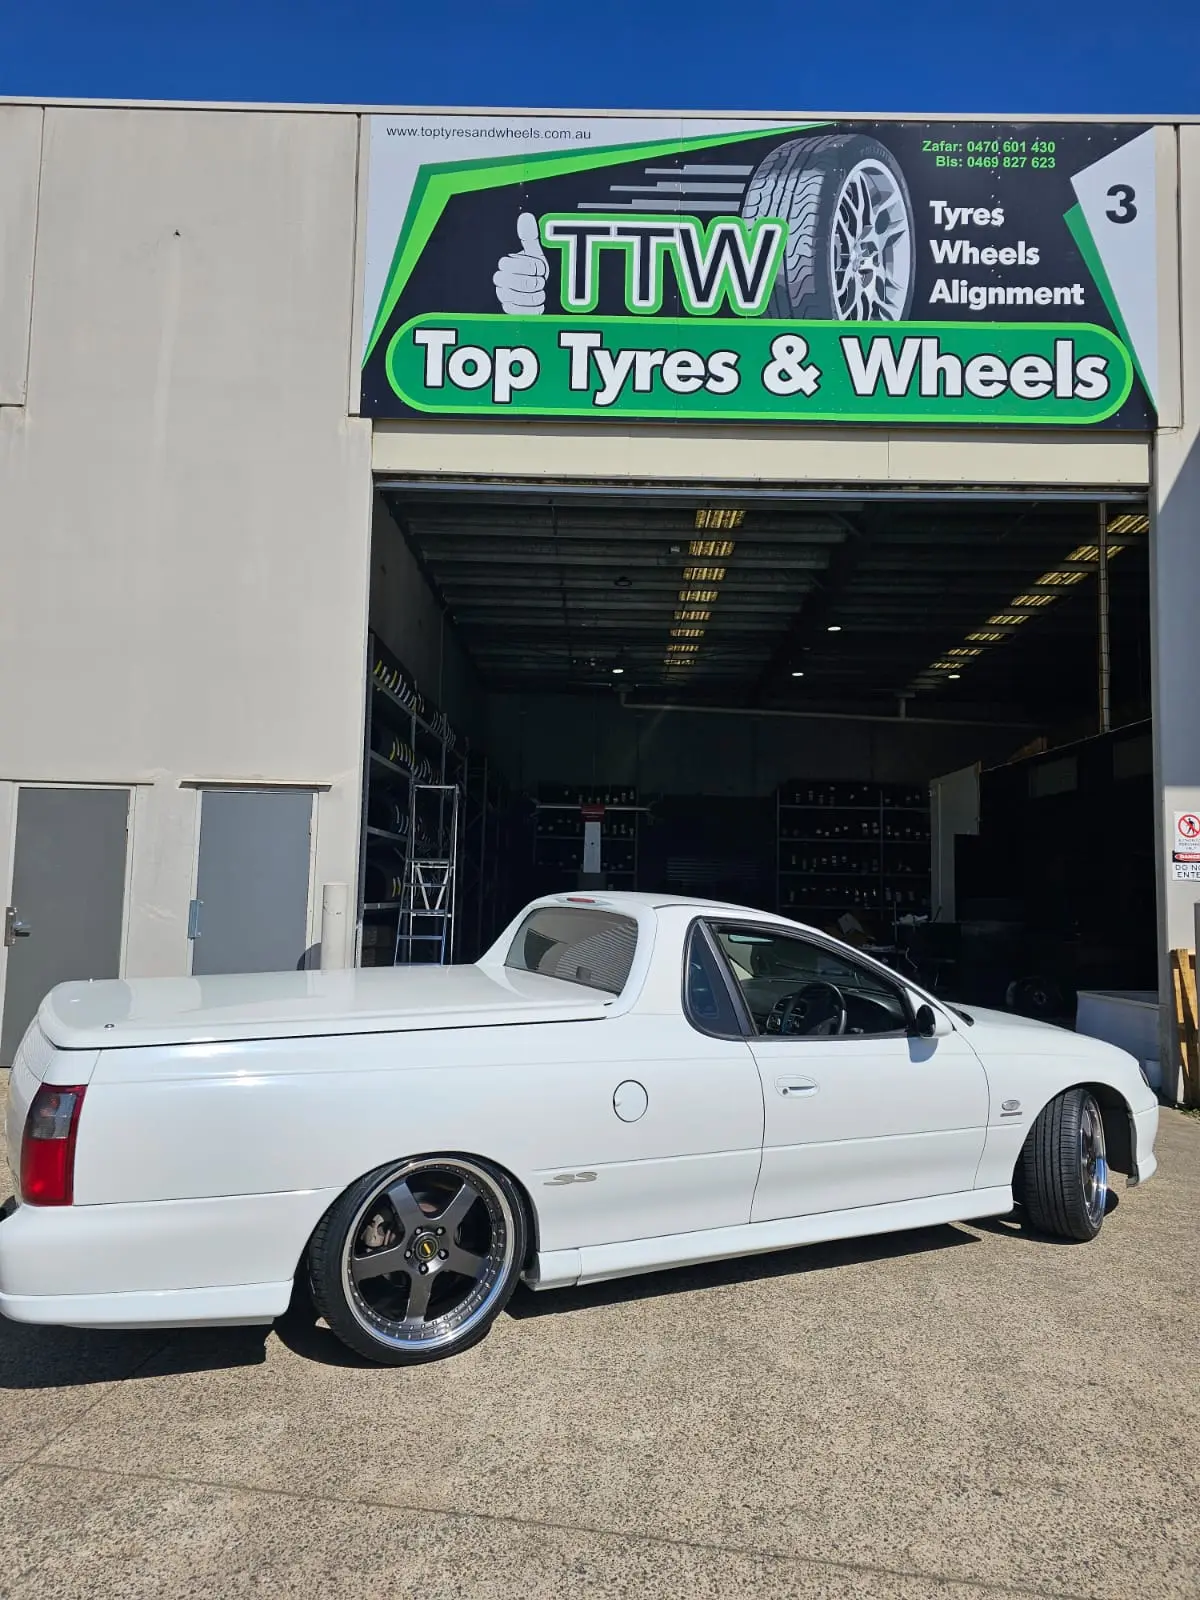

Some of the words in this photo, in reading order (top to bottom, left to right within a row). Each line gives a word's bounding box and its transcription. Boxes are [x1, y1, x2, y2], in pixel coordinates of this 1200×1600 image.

[386, 126, 591, 140] www.toptyresandwheels.com.au
[922, 140, 963, 152] Zafar:
[966, 141, 999, 153] 0470
[1002, 141, 1026, 153] 601
[1030, 141, 1056, 153] 430
[936, 155, 963, 167] Bis:
[966, 156, 999, 168] 0469
[1002, 156, 1027, 168] 827
[1031, 157, 1056, 168] 623
[929, 200, 1005, 230] Tyres
[1105, 184, 1138, 224] 3
[539, 214, 789, 315] TTW
[929, 239, 1040, 265] Wheels
[929, 280, 1085, 310] Alignment
[413, 328, 540, 404] Top
[558, 331, 741, 407] Tyres
[762, 333, 822, 397] &
[840, 336, 1110, 400] Wheels
[543, 1171, 597, 1186] SS
